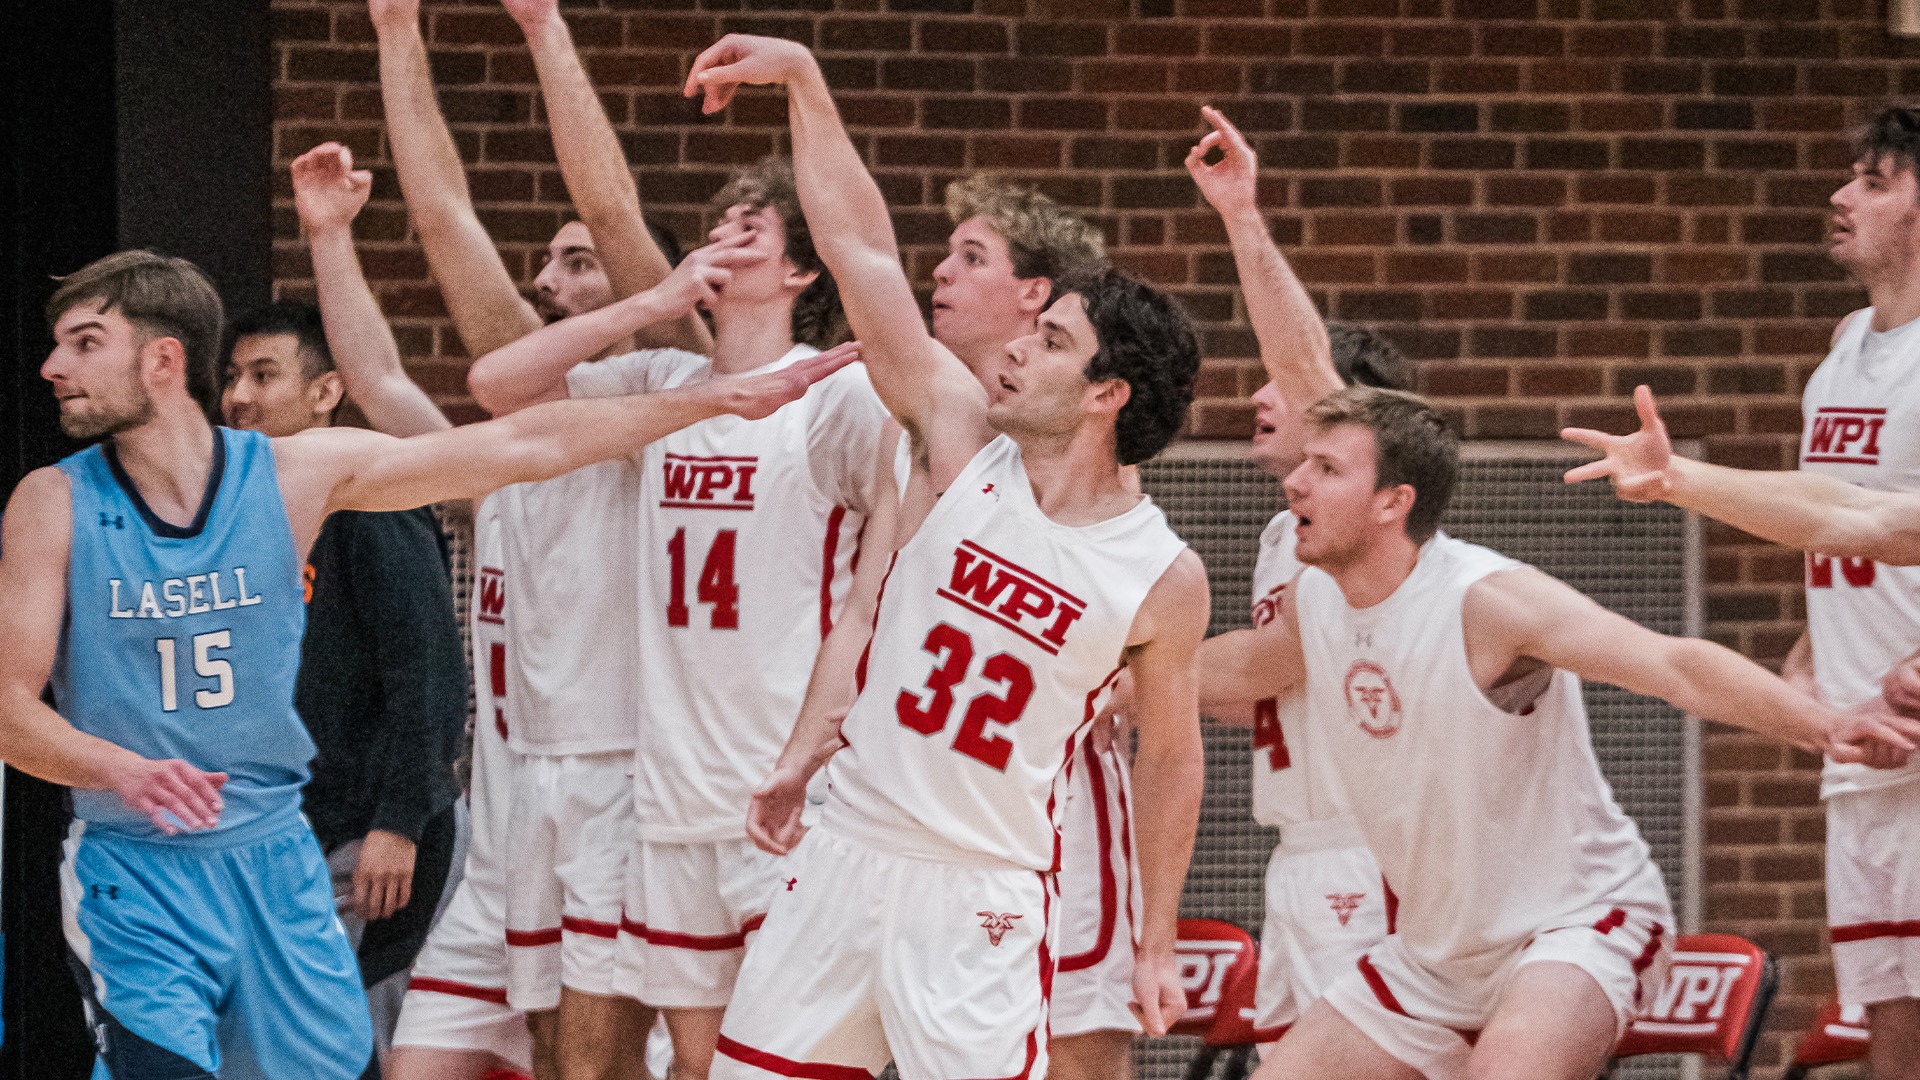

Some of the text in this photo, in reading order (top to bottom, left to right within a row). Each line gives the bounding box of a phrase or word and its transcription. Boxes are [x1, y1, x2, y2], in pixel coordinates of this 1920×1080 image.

[1811, 417, 1885, 456] WPI
[663, 463, 757, 502] WPI
[109, 568, 261, 619] LASELL
[667, 527, 739, 630] 14
[949, 546, 1083, 648] WPI
[156, 630, 235, 712] 15
[895, 620, 1036, 774] 32
[1175, 953, 1237, 1003] PI
